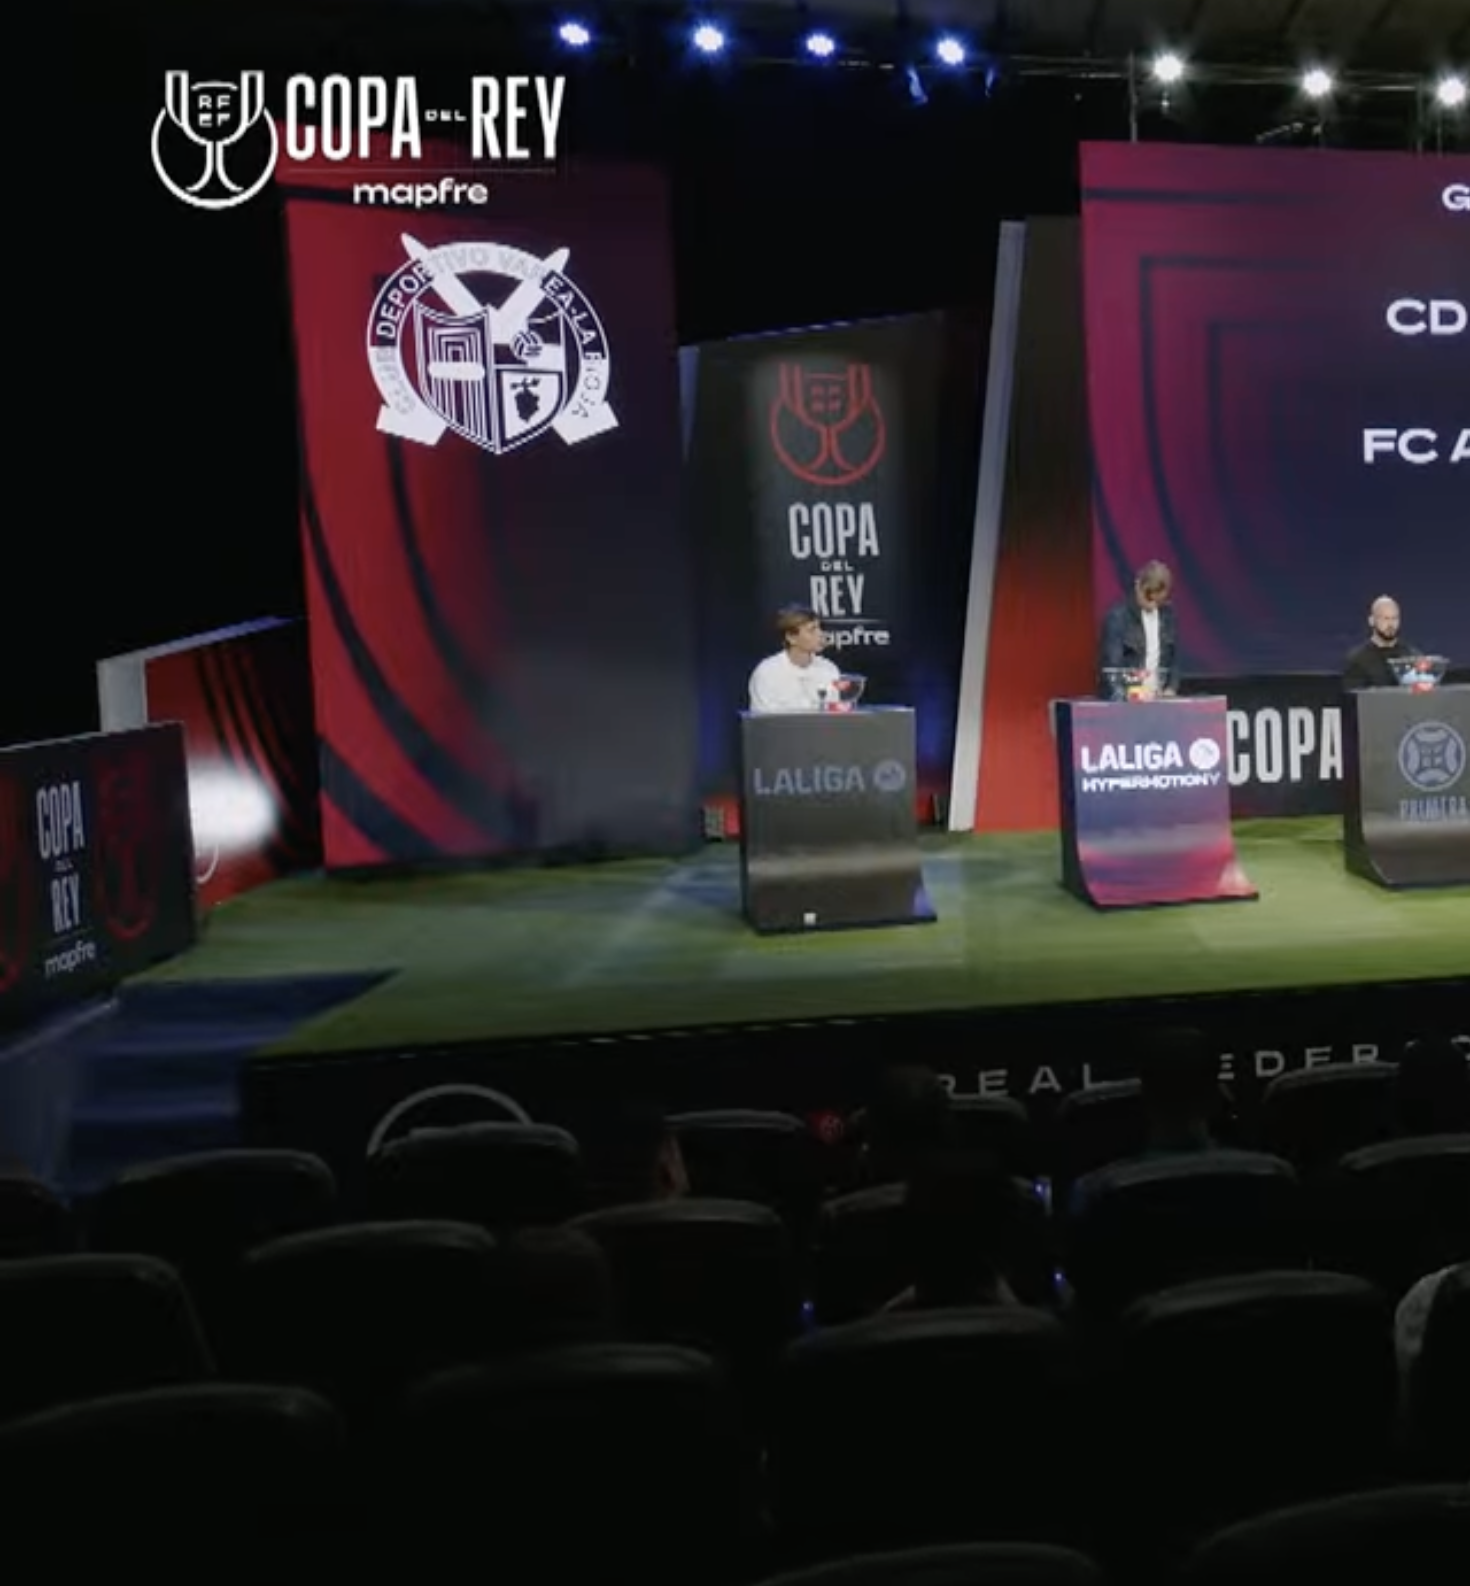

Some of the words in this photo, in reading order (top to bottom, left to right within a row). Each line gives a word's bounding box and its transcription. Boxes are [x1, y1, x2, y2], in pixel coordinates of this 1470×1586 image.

[1386, 298, 1468, 335] CD
[1363, 428, 1438, 464] FC
[789, 502, 879, 559] COPA
[821, 561, 854, 572] DEL
[810, 573, 865, 618] REY
[822, 625, 891, 649] apfre
[1081, 740, 1184, 773] LALIGA
[1226, 708, 1343, 785] COPA
[754, 764, 865, 795] LALIGA
[36, 780, 85, 859] COPA
[51, 872, 81, 934] REY
[45, 940, 96, 979] mapfre
